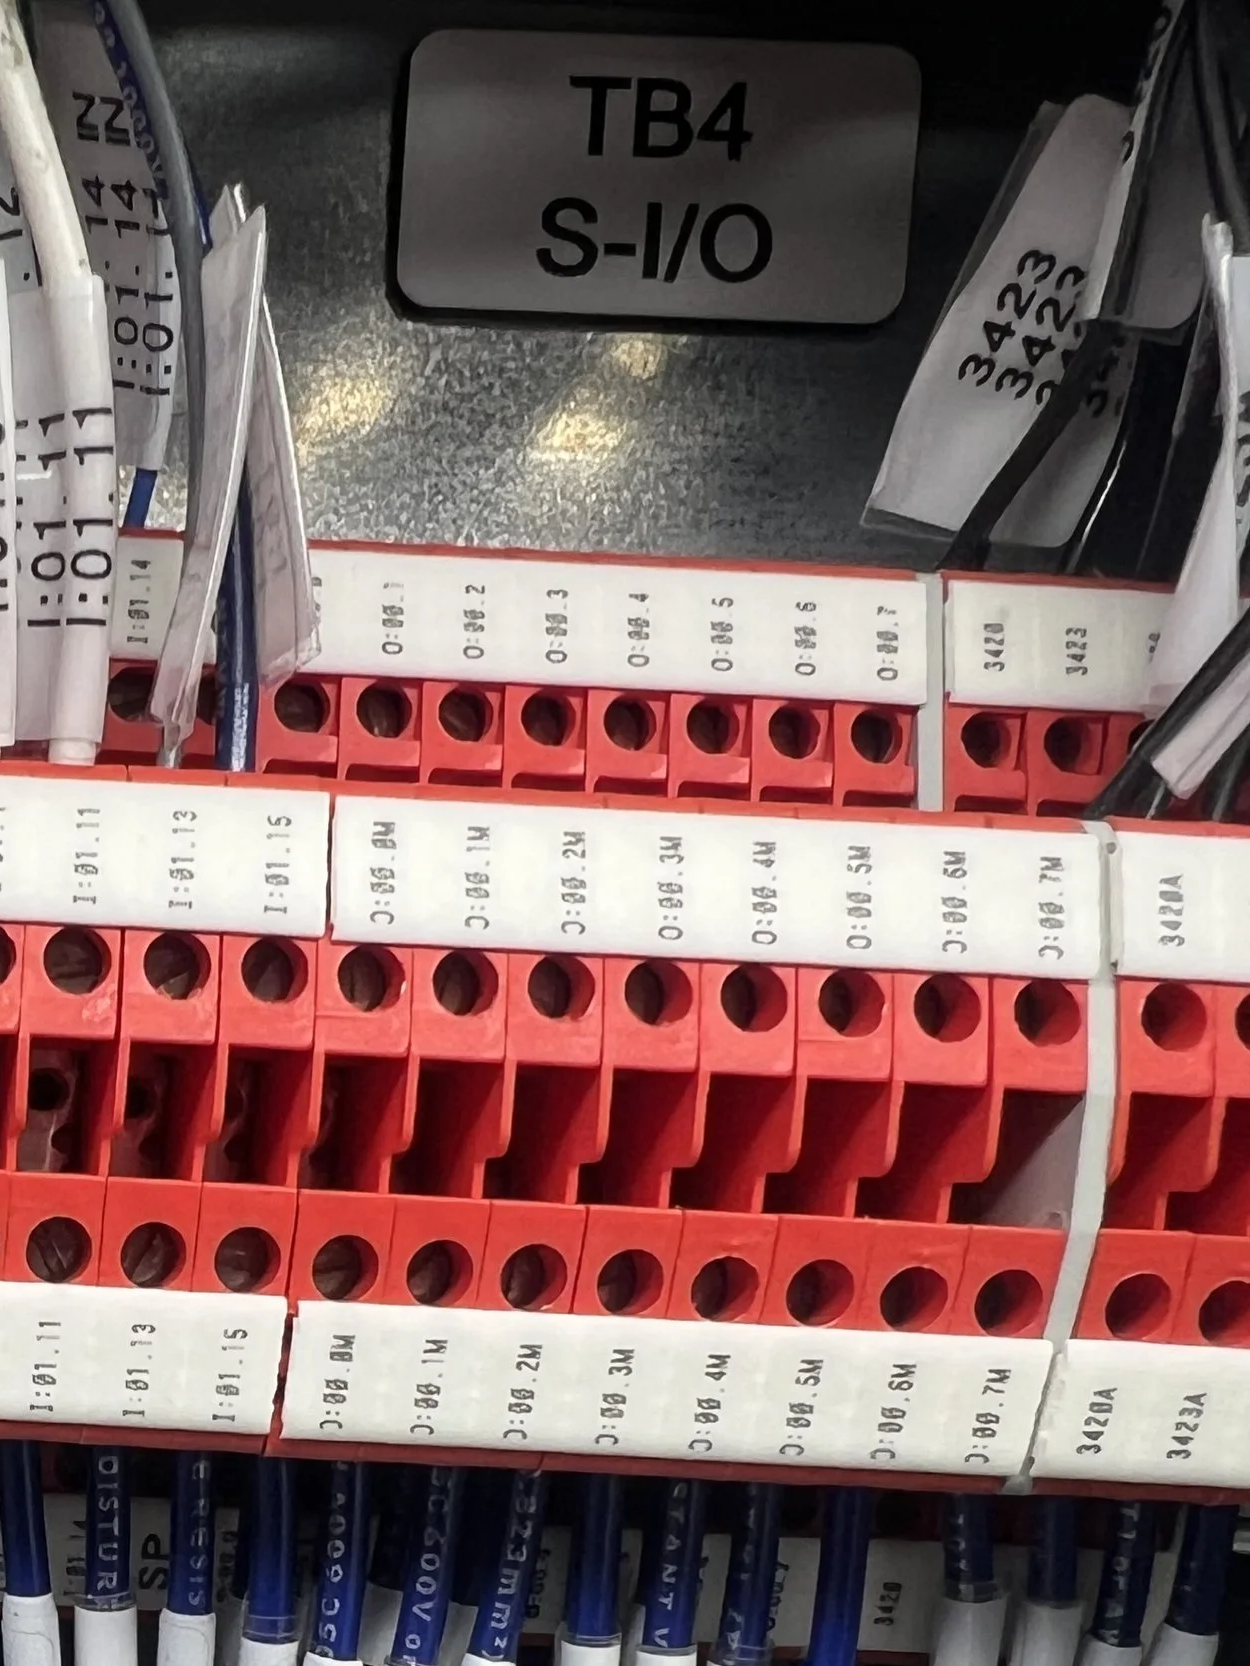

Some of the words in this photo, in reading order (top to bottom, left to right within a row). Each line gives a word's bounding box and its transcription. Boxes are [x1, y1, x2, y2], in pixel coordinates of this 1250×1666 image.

[569, 75, 754, 162] TB4
[536, 198, 774, 284] S-I/O
[958, 250, 1056, 386] 3423
[65, 407, 114, 626] I:01.11
[138, 1532, 171, 1591] SP
